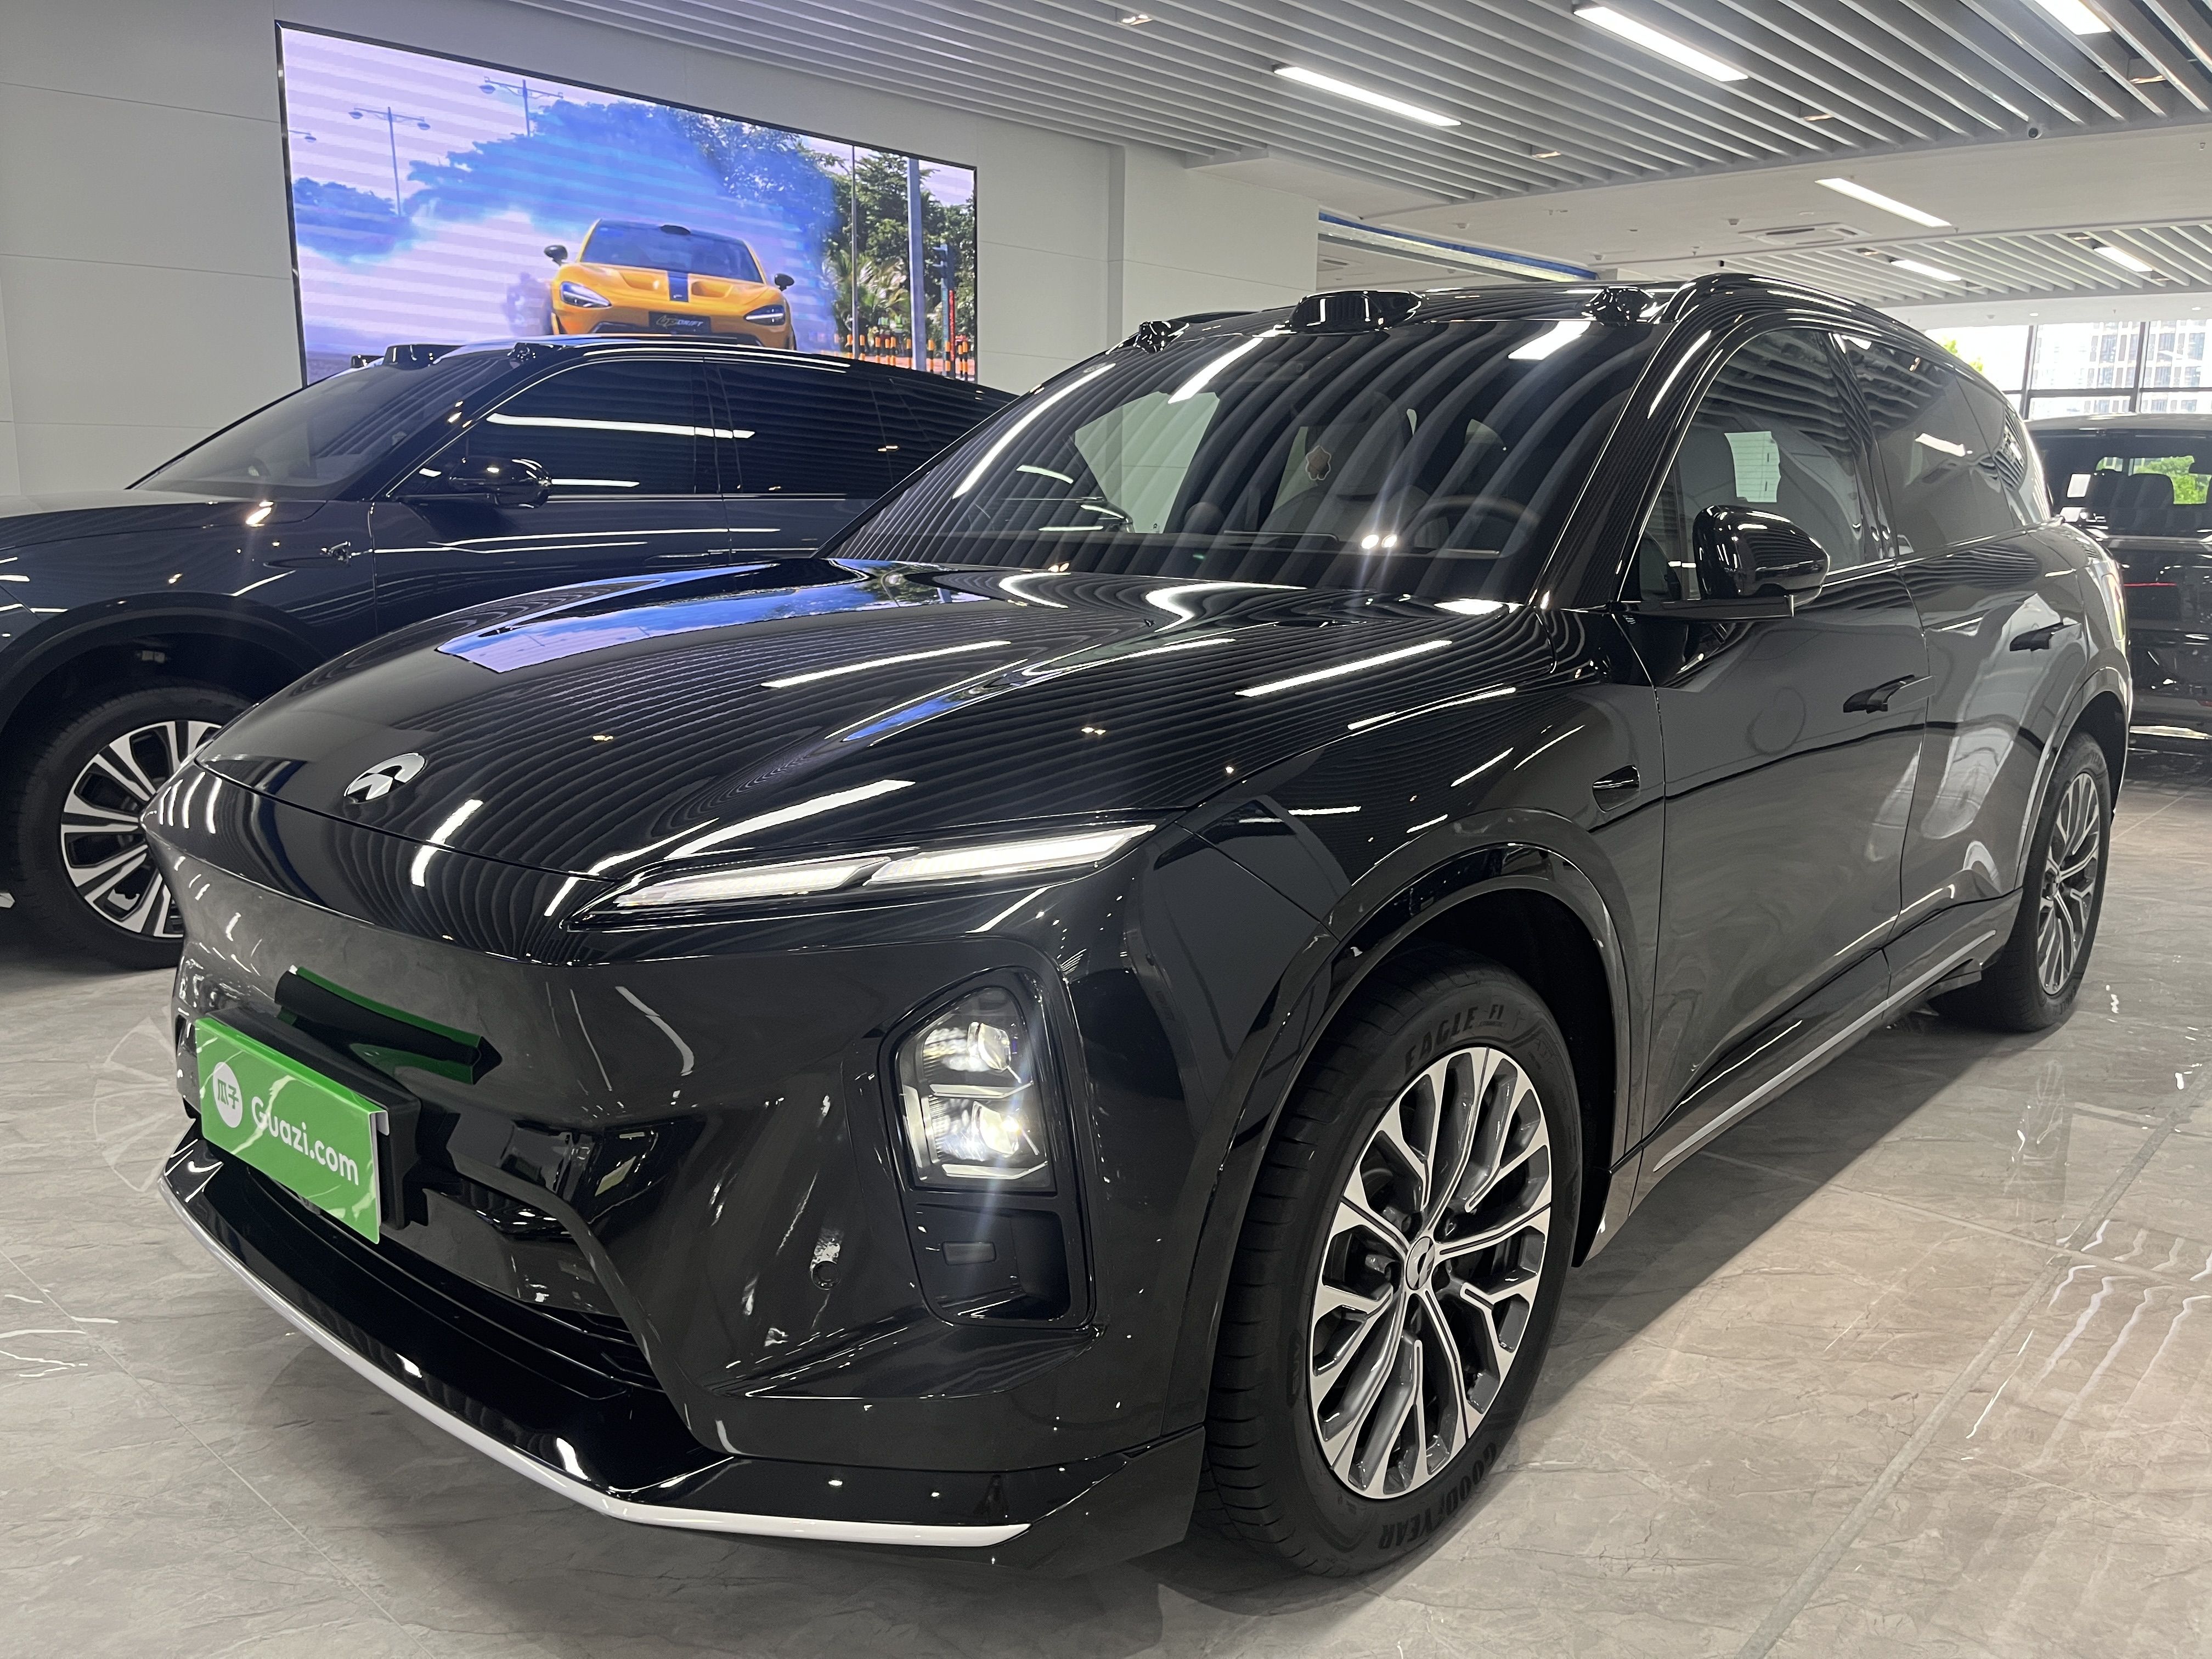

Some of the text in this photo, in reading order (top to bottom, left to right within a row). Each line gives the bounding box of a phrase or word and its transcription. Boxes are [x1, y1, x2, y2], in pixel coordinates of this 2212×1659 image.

[1404, 1006, 1479, 1075] EAGLE
[217, 1079, 239, 1110] 瓜子
[251, 1096, 359, 1186] Guazi.com
[1378, 1442, 1497, 1549] GOODYEAR
